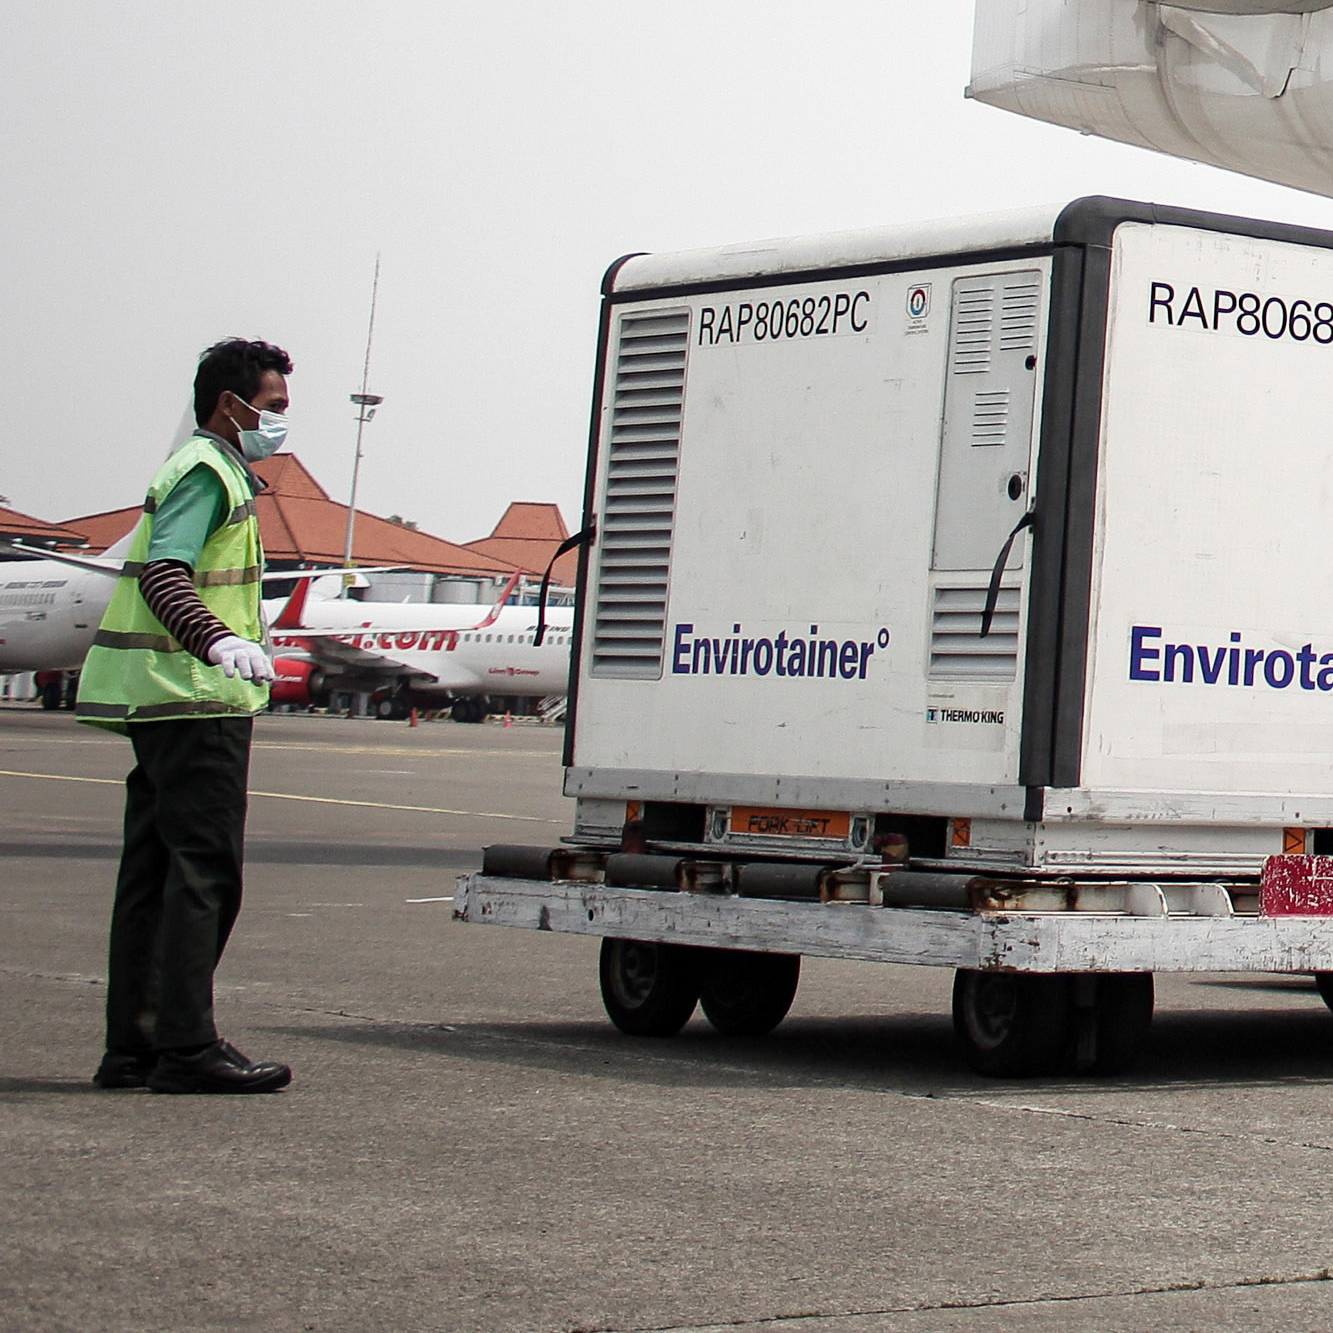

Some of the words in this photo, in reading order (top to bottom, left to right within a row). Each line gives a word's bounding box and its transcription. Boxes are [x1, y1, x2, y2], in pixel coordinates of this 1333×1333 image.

[698, 290, 871, 347] RAP80682PC
[940, 709, 980, 723] THERMO
[981, 710, 1005, 725] KING
